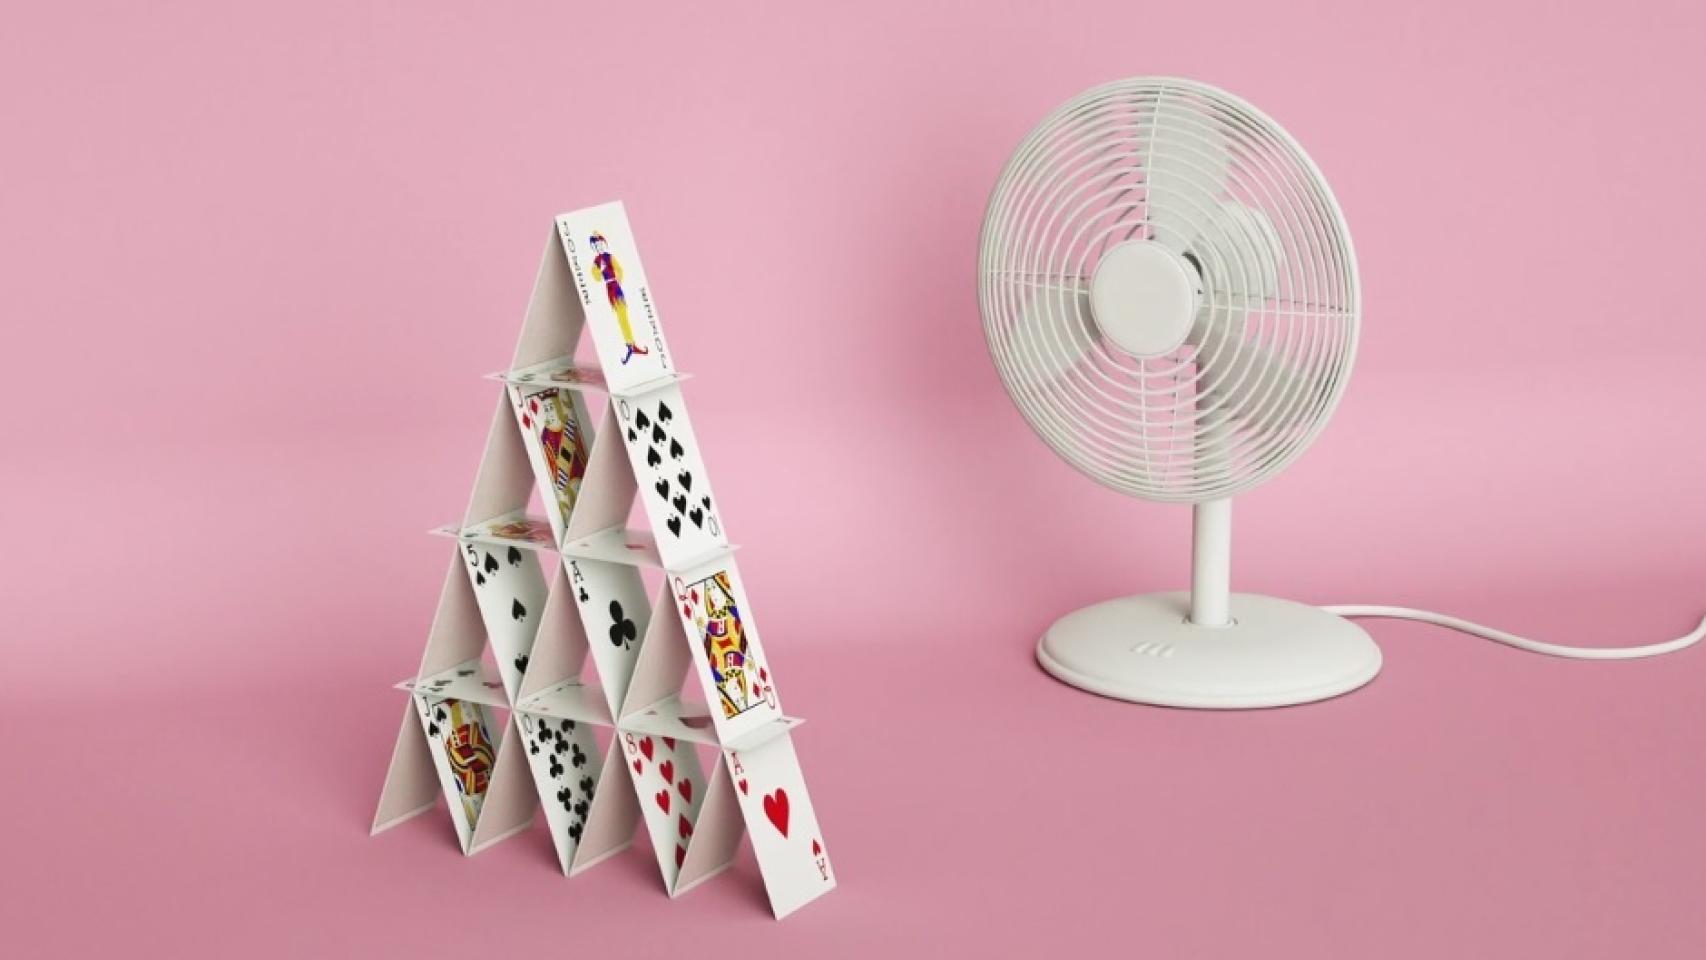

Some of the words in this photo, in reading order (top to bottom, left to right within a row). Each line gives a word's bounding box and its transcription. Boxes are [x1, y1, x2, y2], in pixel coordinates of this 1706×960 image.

[466, 544, 479, 567] 5
[570, 560, 584, 583] A
[422, 696, 430, 717] J
[626, 733, 637, 755] 8
[730, 752, 744, 775] A
[816, 858, 828, 881] A
